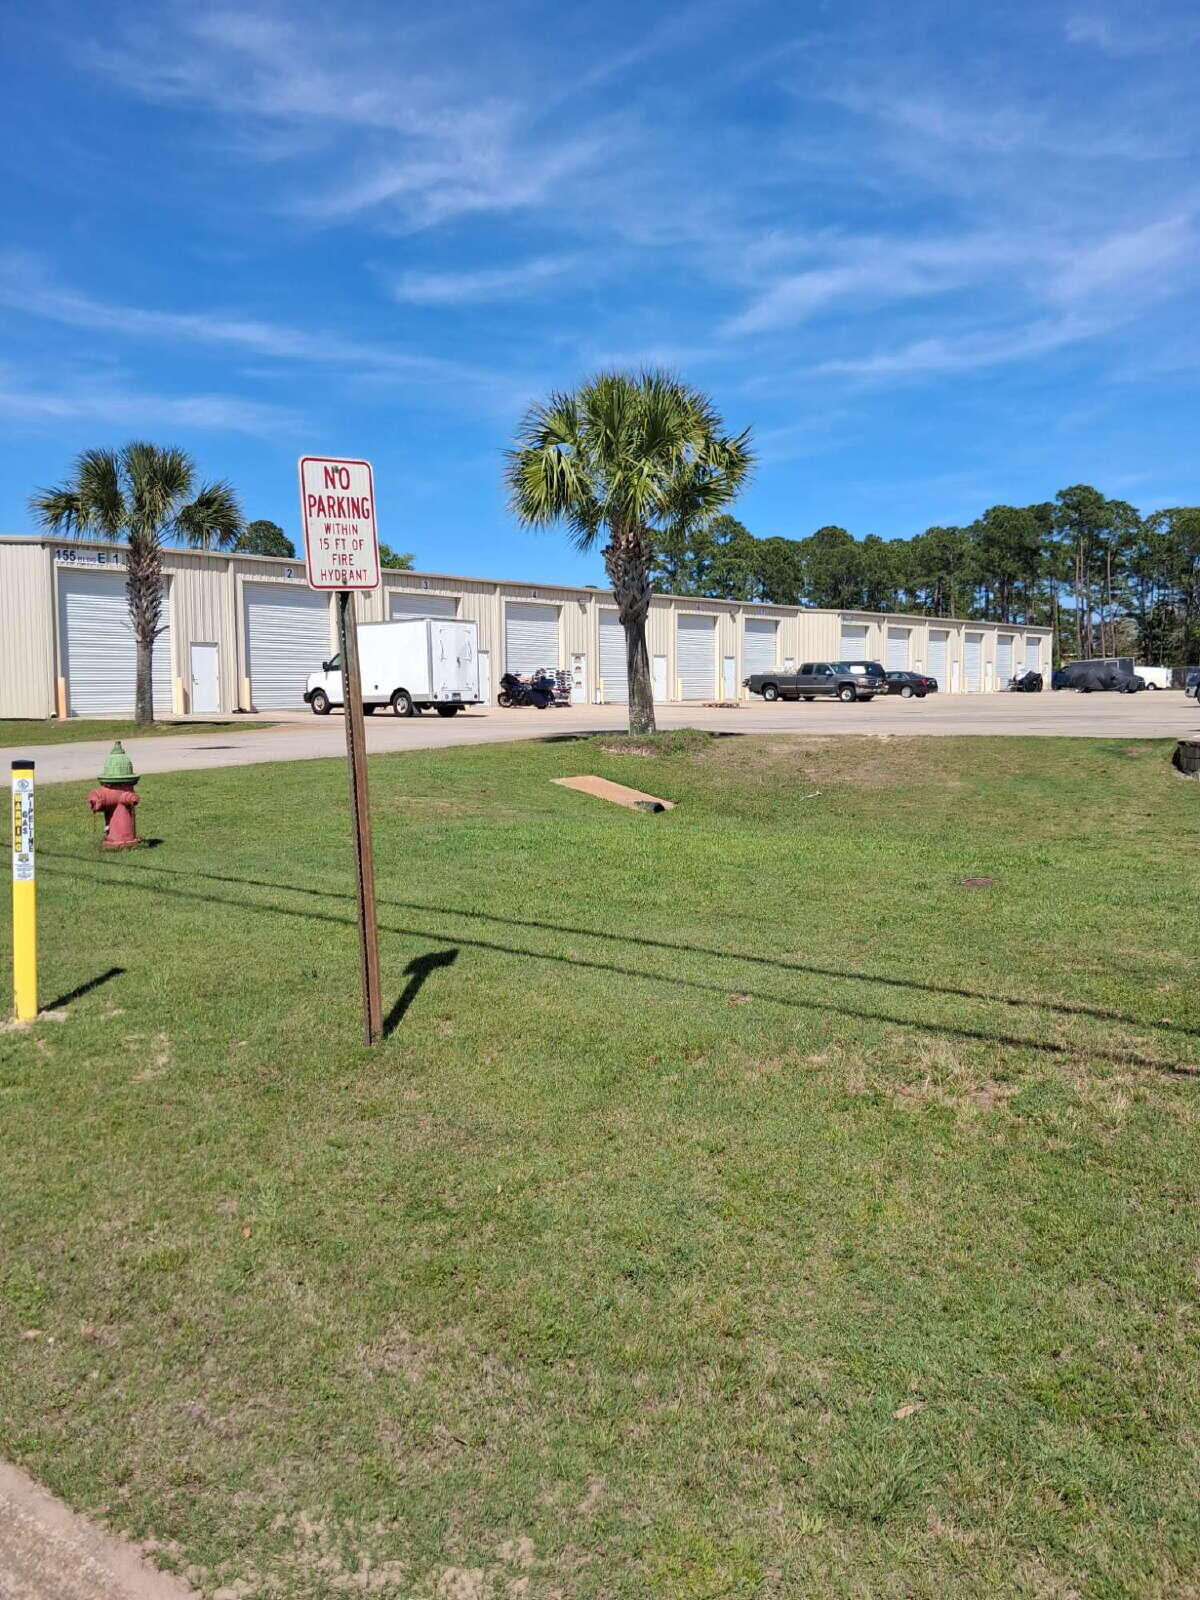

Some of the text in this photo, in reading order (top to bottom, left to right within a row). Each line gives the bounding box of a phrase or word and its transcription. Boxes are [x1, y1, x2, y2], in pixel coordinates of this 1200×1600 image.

[323, 466, 350, 490] NO
[307, 494, 370, 519] PARKING
[324, 523, 359, 536] WITHIN
[320, 538, 365, 550] 15 FT OF
[56, 549, 76, 561] 155
[332, 553, 355, 566] FIRE
[287, 568, 293, 578] 2
[320, 569, 368, 581] HYDRANT
